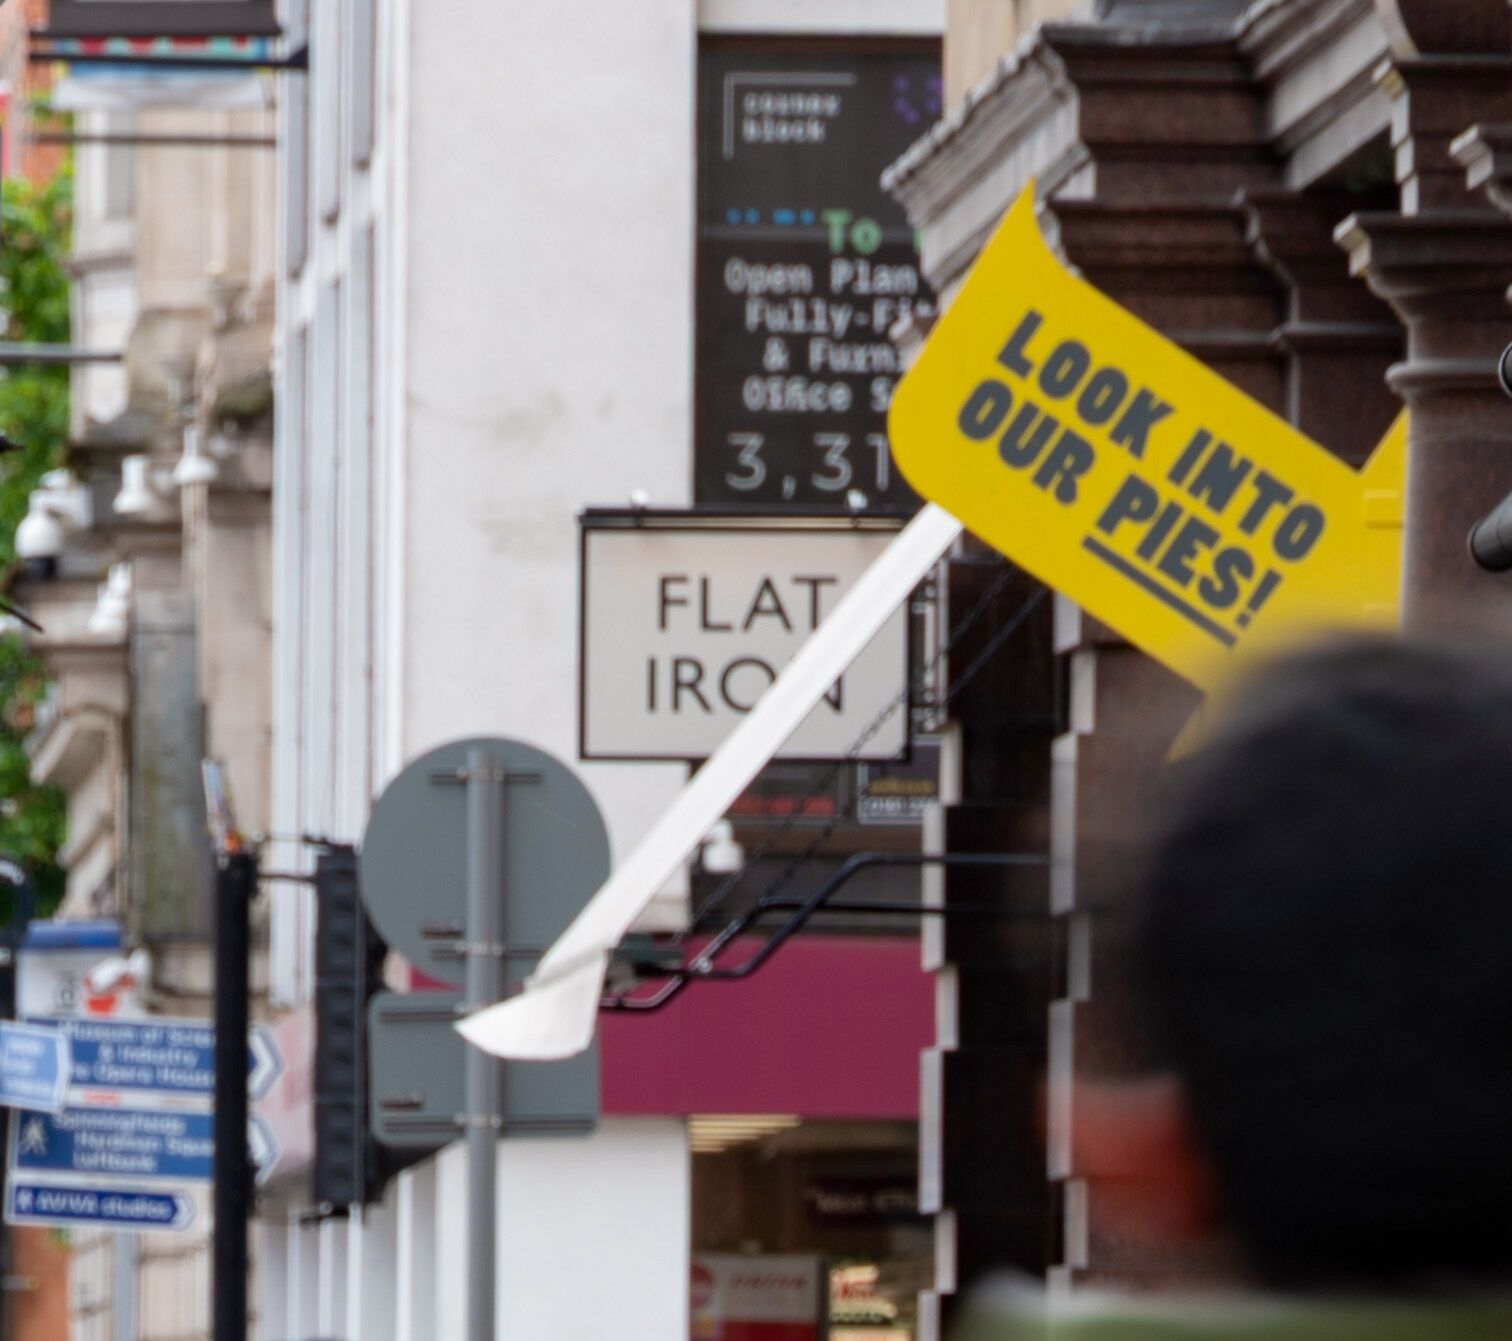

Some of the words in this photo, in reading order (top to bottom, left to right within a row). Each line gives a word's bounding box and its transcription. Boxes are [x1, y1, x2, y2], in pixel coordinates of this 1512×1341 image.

[821, 208, 883, 256] To
[724, 258, 813, 297] Open
[830, 258, 918, 295] Plan
[762, 337, 790, 371] &
[742, 375, 853, 412] Office
[996, 309, 1174, 460] LOOK
[1167, 426, 1325, 563] INTO
[957, 378, 1095, 507] OUR
[1096, 472, 1282, 630] PIES!
[658, 574, 839, 633] FLAT
